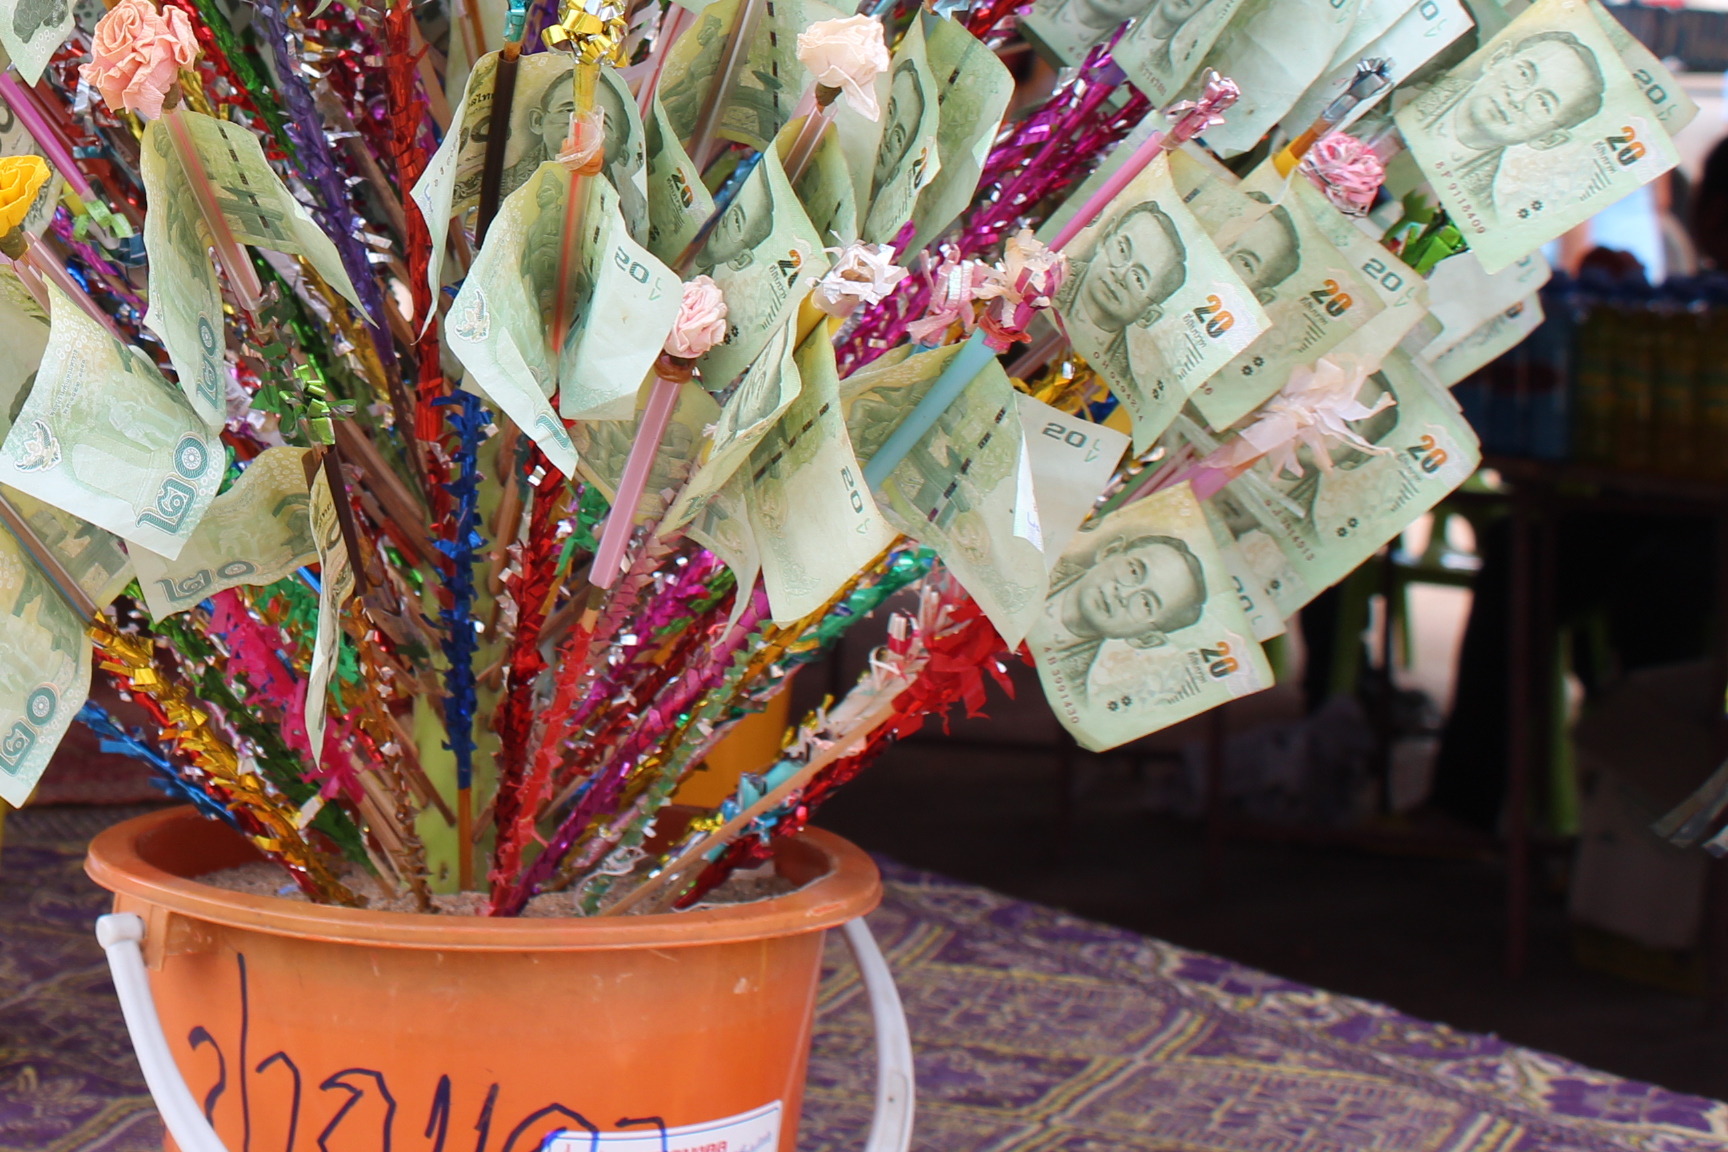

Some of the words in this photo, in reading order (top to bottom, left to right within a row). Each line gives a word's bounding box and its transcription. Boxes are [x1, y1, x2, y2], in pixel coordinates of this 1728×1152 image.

[1631, 67, 1669, 106] 20
[1604, 125, 1641, 168] 20
[672, 168, 694, 208] 20
[613, 246, 650, 285] 20
[1361, 257, 1405, 294] 20
[1192, 292, 1236, 340] 20
[1310, 278, 1355, 317] 20
[197, 311, 216, 409] ๒๐
[1040, 421, 1087, 448] 20
[1407, 433, 1448, 476] 20
[136, 432, 209, 534] ๒๐
[841, 465, 863, 517] 20
[154, 561, 258, 603] ๒๐
[1199, 641, 1237, 679] 20
